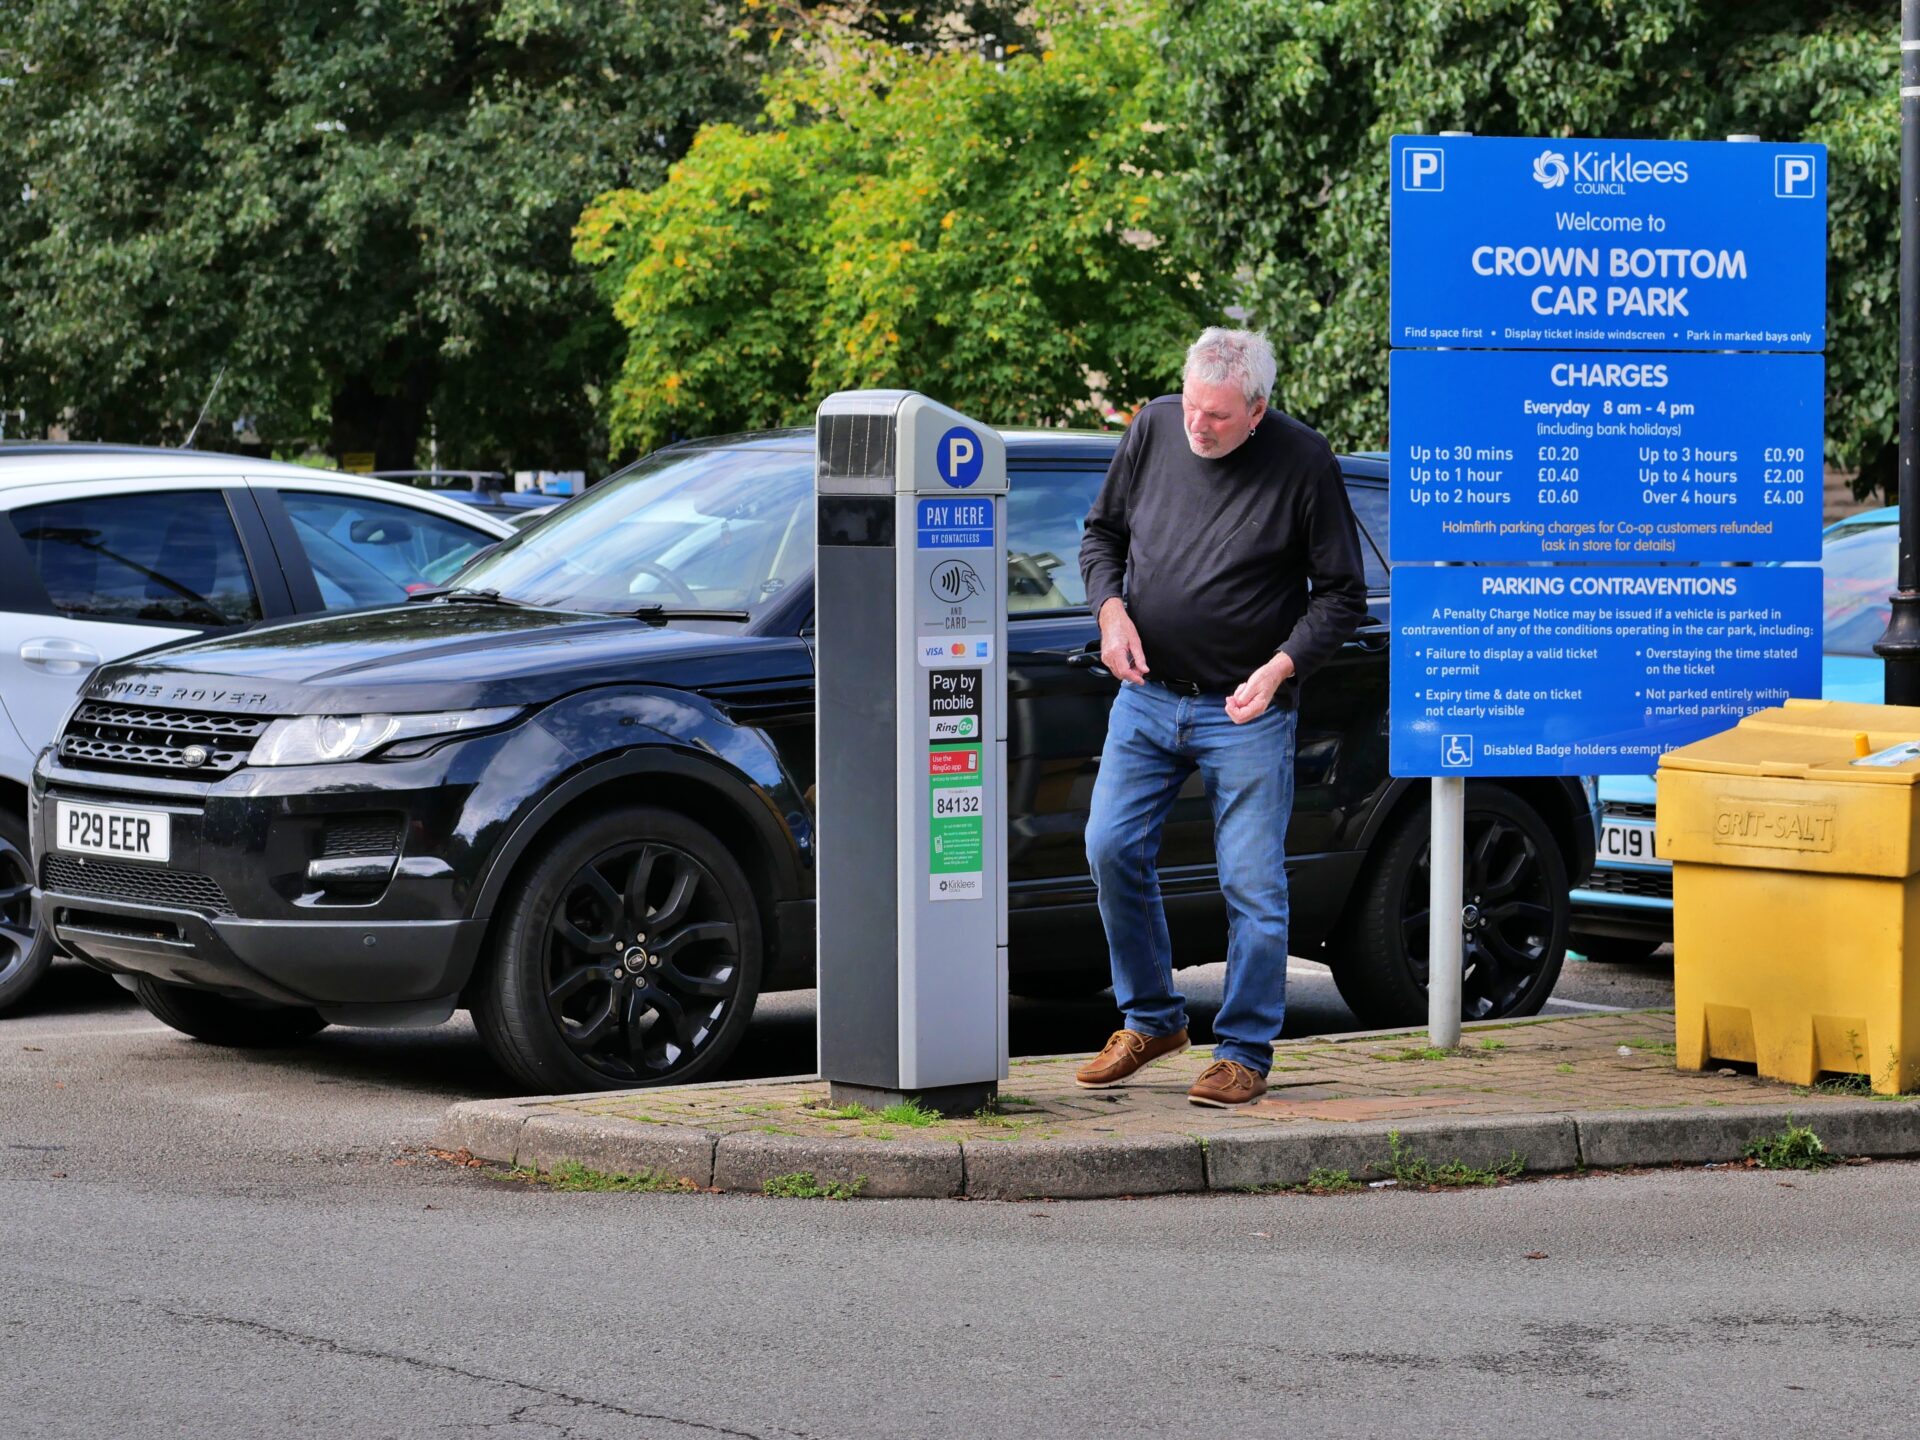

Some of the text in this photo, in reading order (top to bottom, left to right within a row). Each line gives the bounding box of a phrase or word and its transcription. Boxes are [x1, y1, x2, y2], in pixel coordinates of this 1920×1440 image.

[1413, 153, 1438, 187] P
[1574, 152, 1689, 183] Kirklees
[1785, 160, 1809, 193] P
[1574, 183, 1626, 195] COUNCIL
[1556, 211, 1666, 232] Welcome to
[1472, 246, 1747, 279] CROWN BOTTOM
[1531, 285, 1689, 317] CAR PARK
[1405, 326, 1483, 340] Find space first
[1504, 328, 1665, 341] Display ticket inside windscreen
[1687, 330, 1812, 343] Park in marked bays only
[1551, 363, 1668, 387] CHARGES
[1524, 399, 1590, 418] Everyday
[1603, 400, 1613, 415] 8
[1617, 403, 1641, 415] am
[1656, 401, 1666, 415] 4
[1670, 404, 1695, 419] pm
[1537, 422, 1681, 438] (including bank holidays)
[950, 438, 974, 478] P
[1410, 445, 1513, 464] Up to 30 mins
[1538, 446, 1579, 461] £0.20
[1639, 447, 1738, 465] Up to 3 hours
[1764, 448, 1804, 462] £0.90
[1410, 467, 1503, 485] Up to 1 hour
[1538, 467, 1579, 482] £0.40
[1639, 468, 1738, 486] Up to 4 hours
[1764, 469, 1804, 483] £2.00
[1410, 488, 1511, 506] Up to 2 hours
[1538, 489, 1579, 504] £0.60
[1643, 489, 1737, 504] Over 4 hours
[1763, 490, 1804, 504] £4.00
[927, 506, 984, 526] PAY HERE
[1442, 520, 1773, 537] Holmfirth parking charges for Co-op customers refunded
[931, 533, 980, 544] BY CONTACTLESS
[1541, 538, 1676, 552] (ask in store for details)
[1482, 577, 1737, 595] PARKING CONTRAVENTIONS
[950, 607, 962, 616] AND
[1432, 608, 1781, 622] A Penalty Charge Notice may be issued if a vehicle is parked in
[945, 616, 967, 630] CARD
[1401, 624, 1813, 638] contravention of any of the conditions operating in the car park, including:
[925, 647, 944, 656] VISA
[1426, 648, 1597, 661] Failure to display a valid ticket
[1646, 647, 1798, 661] Overstaying the time stated
[1426, 664, 1480, 677] or permit
[1646, 663, 1715, 675] on the ticket
[933, 674, 976, 692] Pay by
[172, 688, 267, 704] ROVER
[933, 694, 974, 710] mobile
[1426, 689, 1582, 703] Expiry time & date on ticket
[1646, 688, 1790, 702] Not parked entirely within
[1425, 705, 1525, 718] not clearly visible
[1645, 706, 1653, 715] a
[1655, 704, 1699, 715] marked
[1701, 704, 1745, 718] parking
[936, 720, 972, 734] RingGo
[1483, 744, 1533, 755] Disabled
[1536, 744, 1572, 758] Badge
[1574, 743, 1617, 755] holders
[1620, 744, 1663, 757] exempt
[932, 754, 952, 763] Use the
[951, 764, 962, 772] app
[937, 796, 979, 814] 84132
[69, 810, 150, 853] P29 EER
[1717, 811, 1833, 841] GRIT-SALT
[948, 879, 976, 889] Kirklees
